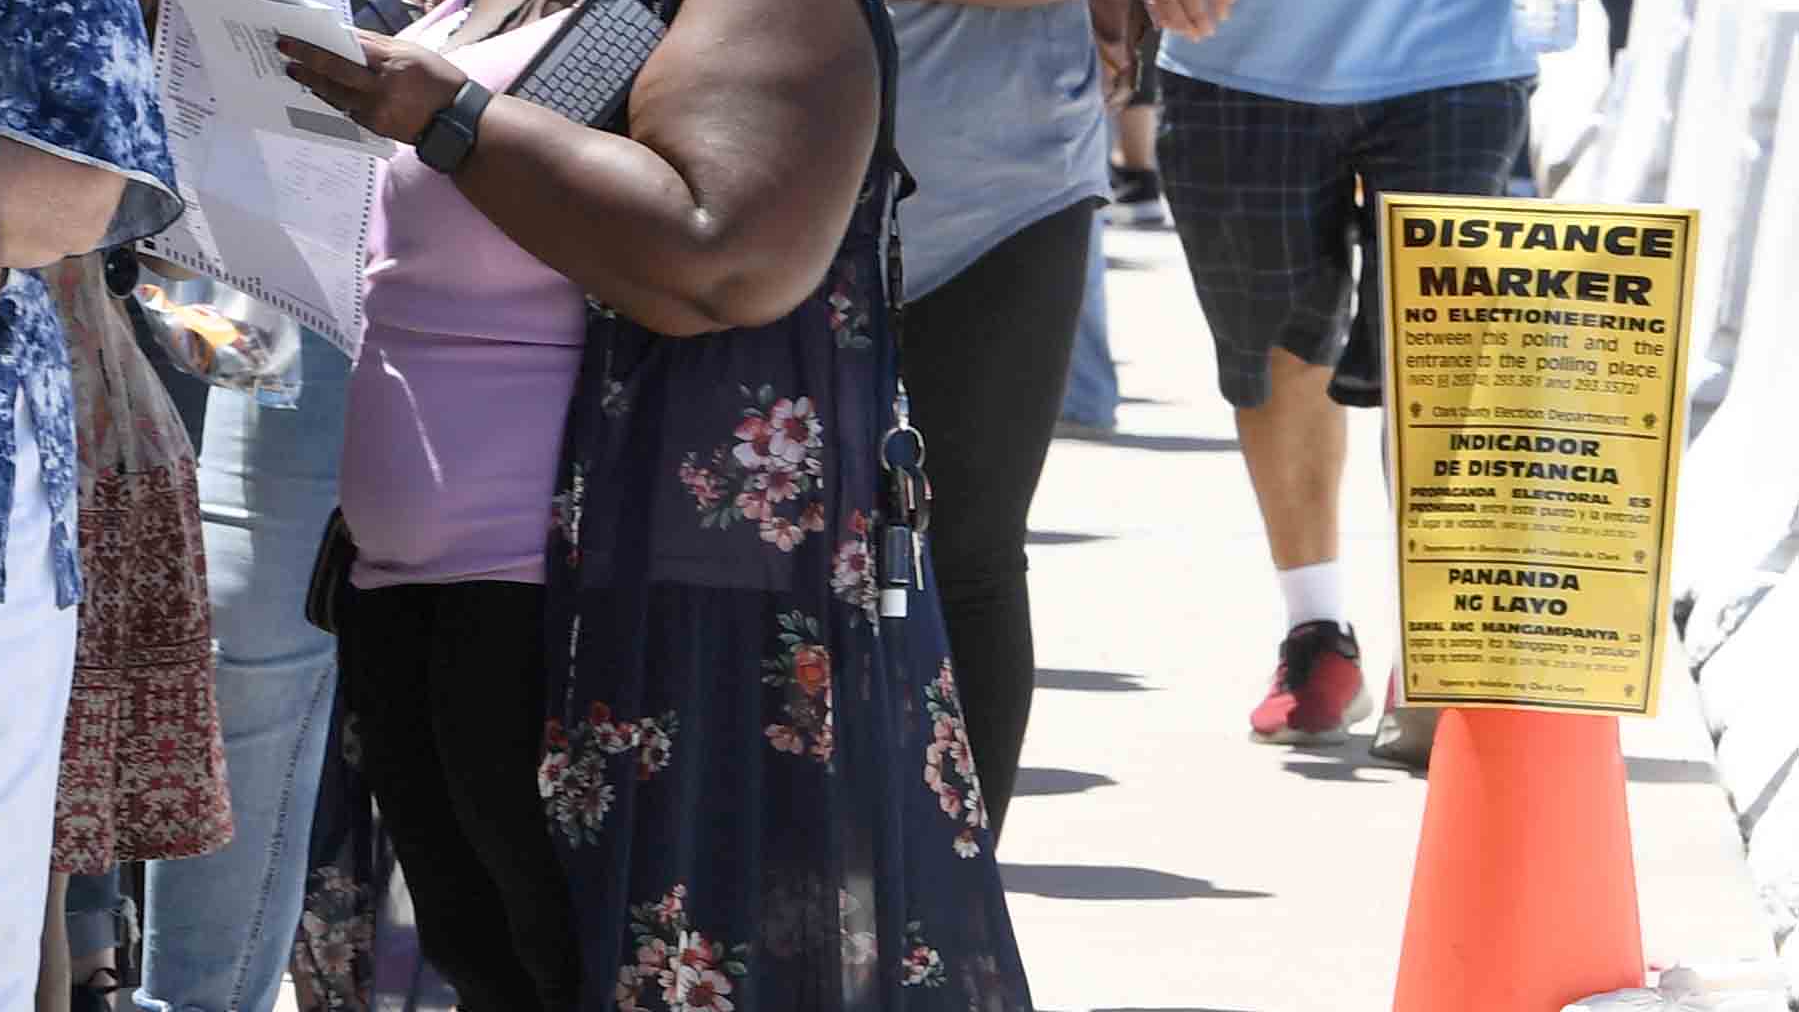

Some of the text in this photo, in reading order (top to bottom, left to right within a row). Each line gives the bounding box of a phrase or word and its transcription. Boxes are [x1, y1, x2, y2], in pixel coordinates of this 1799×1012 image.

[1403, 218, 1674, 259] DISTANCE
[1419, 266, 1653, 306] MARKER
[1405, 307, 1665, 334] NO ELECTIONEERING
[1405, 330, 1664, 357] between this point and the
[1406, 352, 1473, 369] entrance
[1498, 352, 1528, 369] the
[1536, 355, 1597, 376] polling
[1607, 360, 1661, 379] place.
[1496, 405, 1543, 419] Election
[1450, 434, 1600, 457] INDICADOR
[1434, 460, 1619, 485] DE DISTANCIA
[1511, 488, 1612, 505] ELECTORAL
[1628, 496, 1651, 508] ES
[1448, 568, 1580, 591] PANANDA
[1454, 595, 1568, 616] NG LAYO
[1482, 622, 1619, 641] MANGAMPANYA
